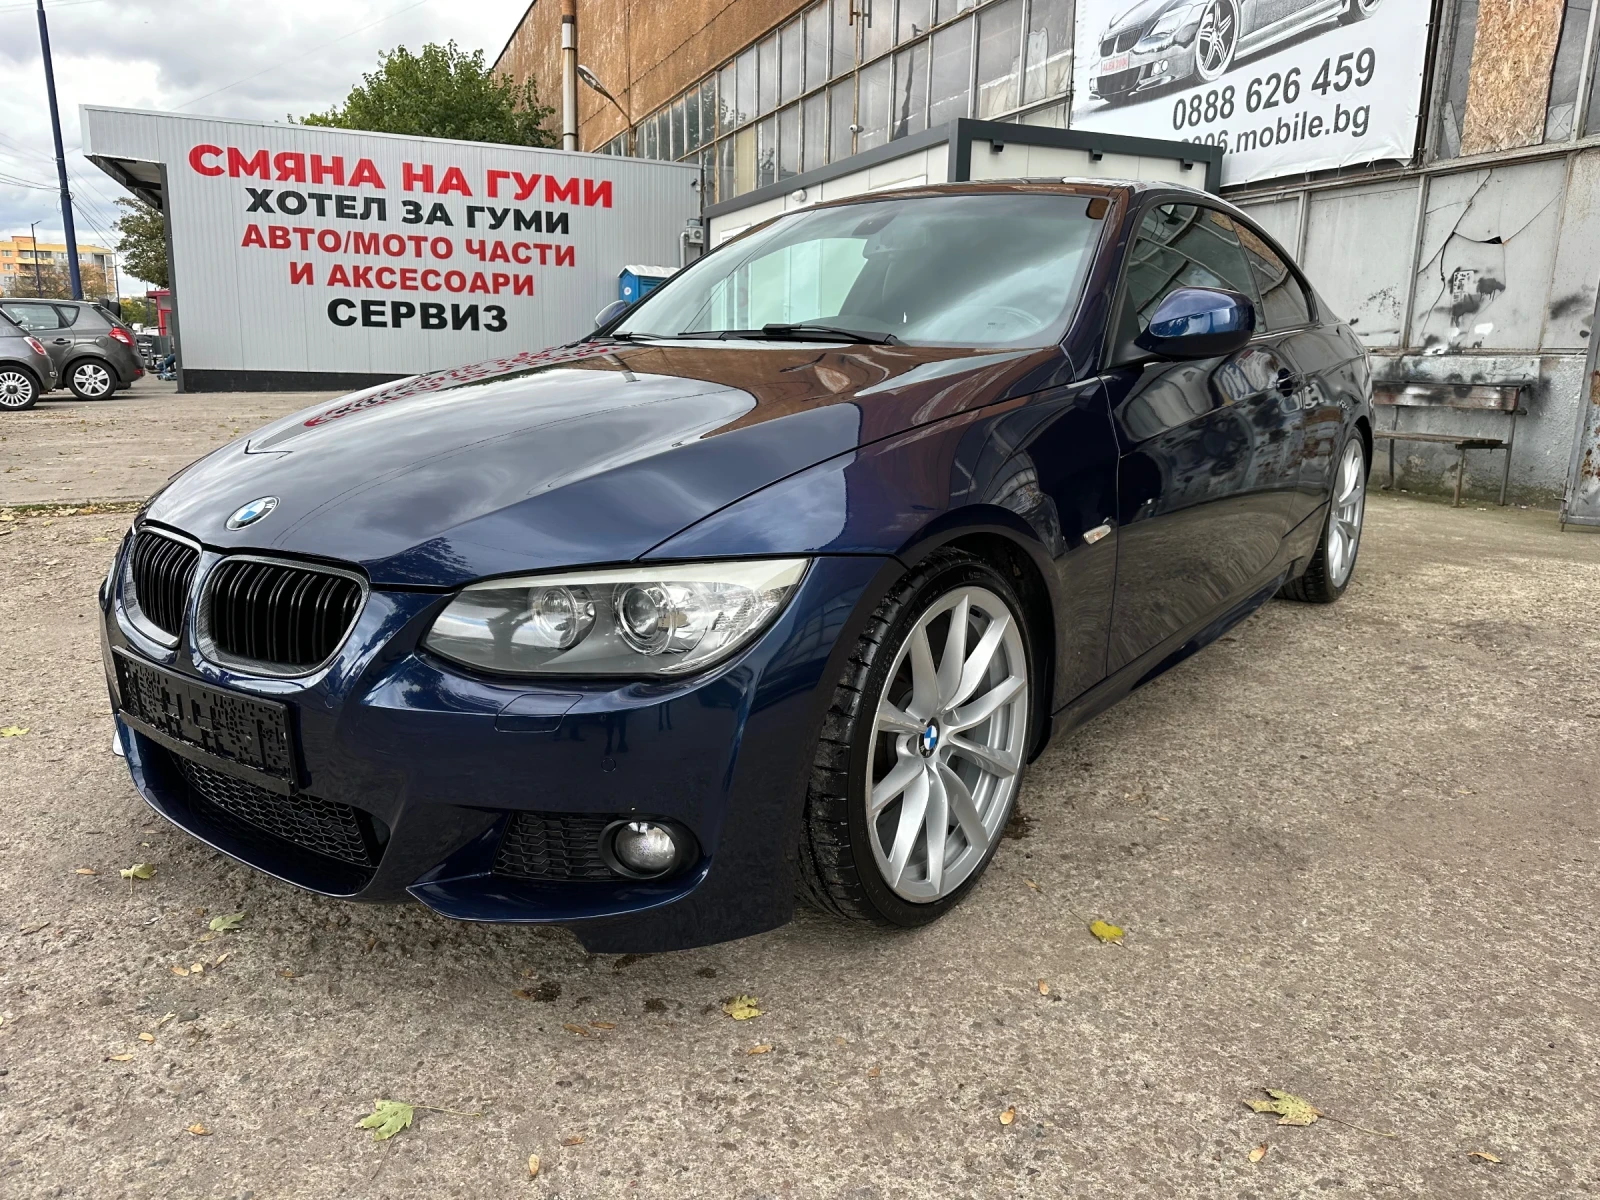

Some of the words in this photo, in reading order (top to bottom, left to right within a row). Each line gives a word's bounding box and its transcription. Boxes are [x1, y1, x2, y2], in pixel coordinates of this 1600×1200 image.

[1173, 85, 1235, 131] 0888
[1246, 67, 1301, 113] 626
[1311, 47, 1376, 96] 459
[1181, 103, 1370, 155] 6.mobile.bg
[189, 144, 386, 190] СМЯНА
[403, 162, 472, 197] НА
[487, 170, 613, 208] ГУМИ
[245, 188, 387, 222] ХОТЕЛ
[402, 200, 454, 227] ЗА
[467, 206, 569, 235] ГУМИ
[242, 224, 453, 260] АВТО/МОТО
[466, 239, 575, 267] ЧАСТИ
[290, 262, 314, 286] И
[327, 264, 534, 297] АКСЕСОАРИ
[327, 298, 508, 332] СЕРВИЗ
